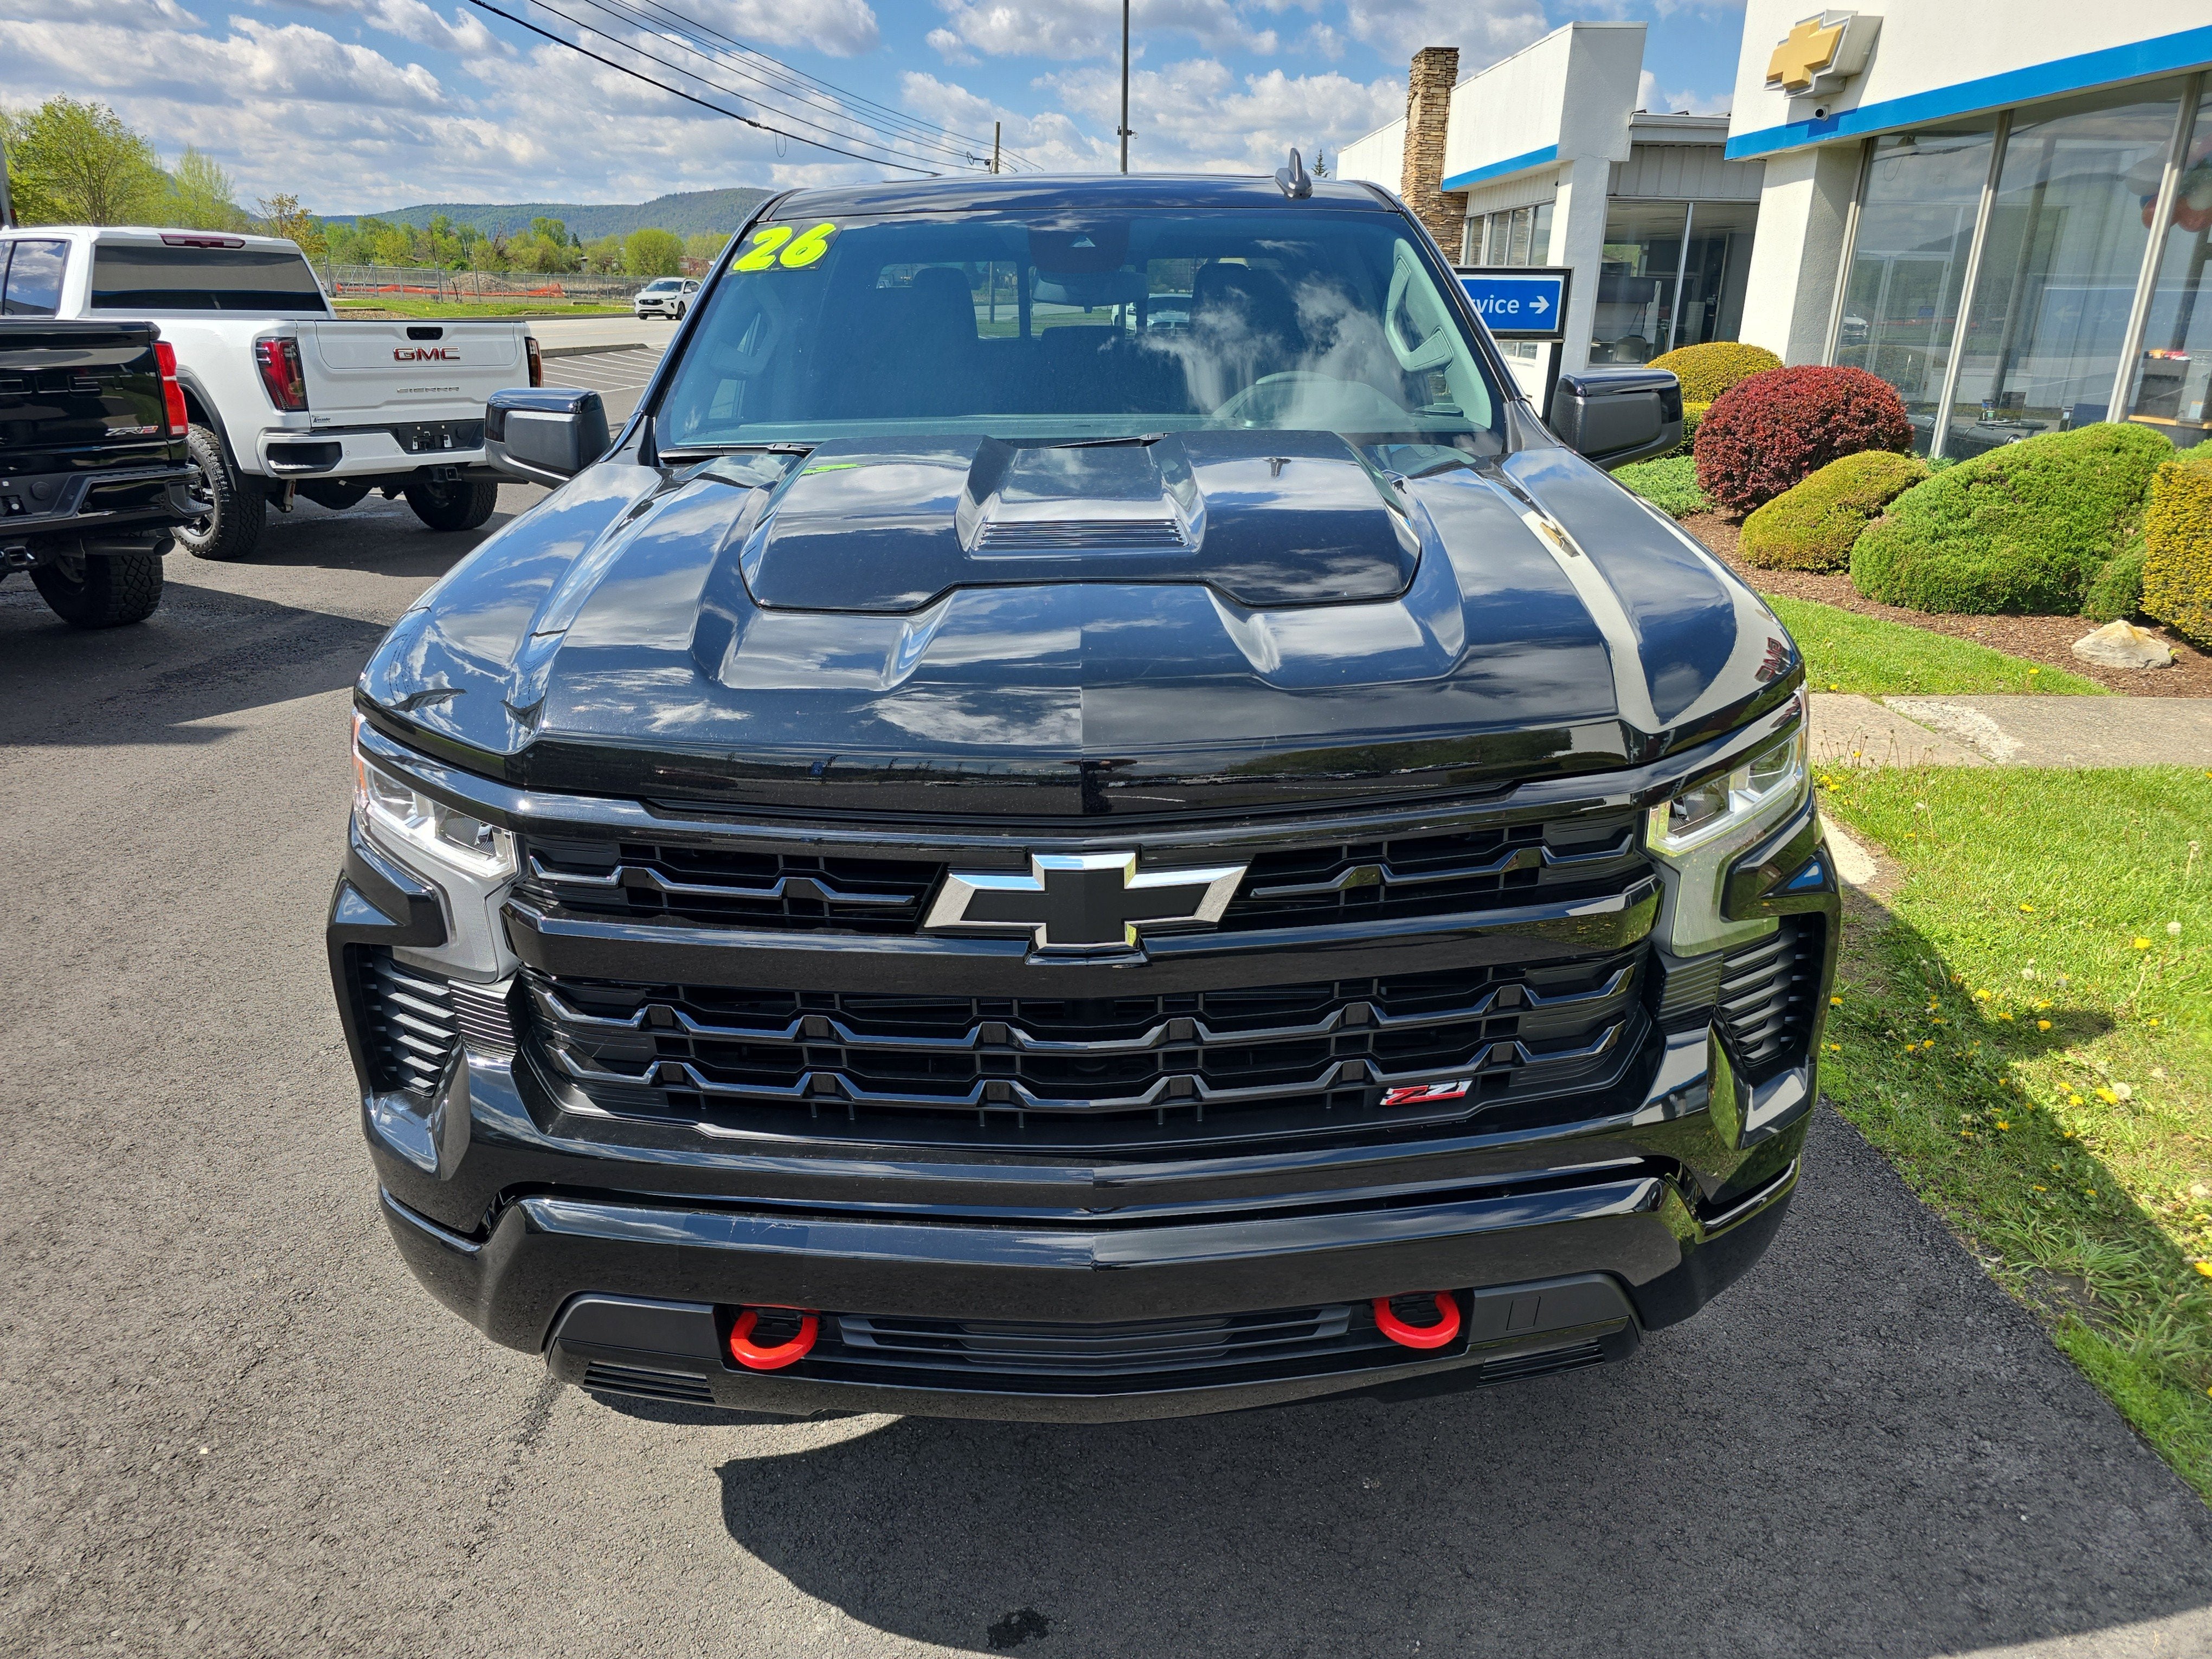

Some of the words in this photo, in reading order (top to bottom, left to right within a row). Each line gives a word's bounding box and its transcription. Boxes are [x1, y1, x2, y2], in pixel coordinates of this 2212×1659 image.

[733, 223, 837, 272] 26
[393, 347, 460, 362] GMC
[105, 426, 158, 436] ZR2
[1379, 1080, 1472, 1105] Z71
